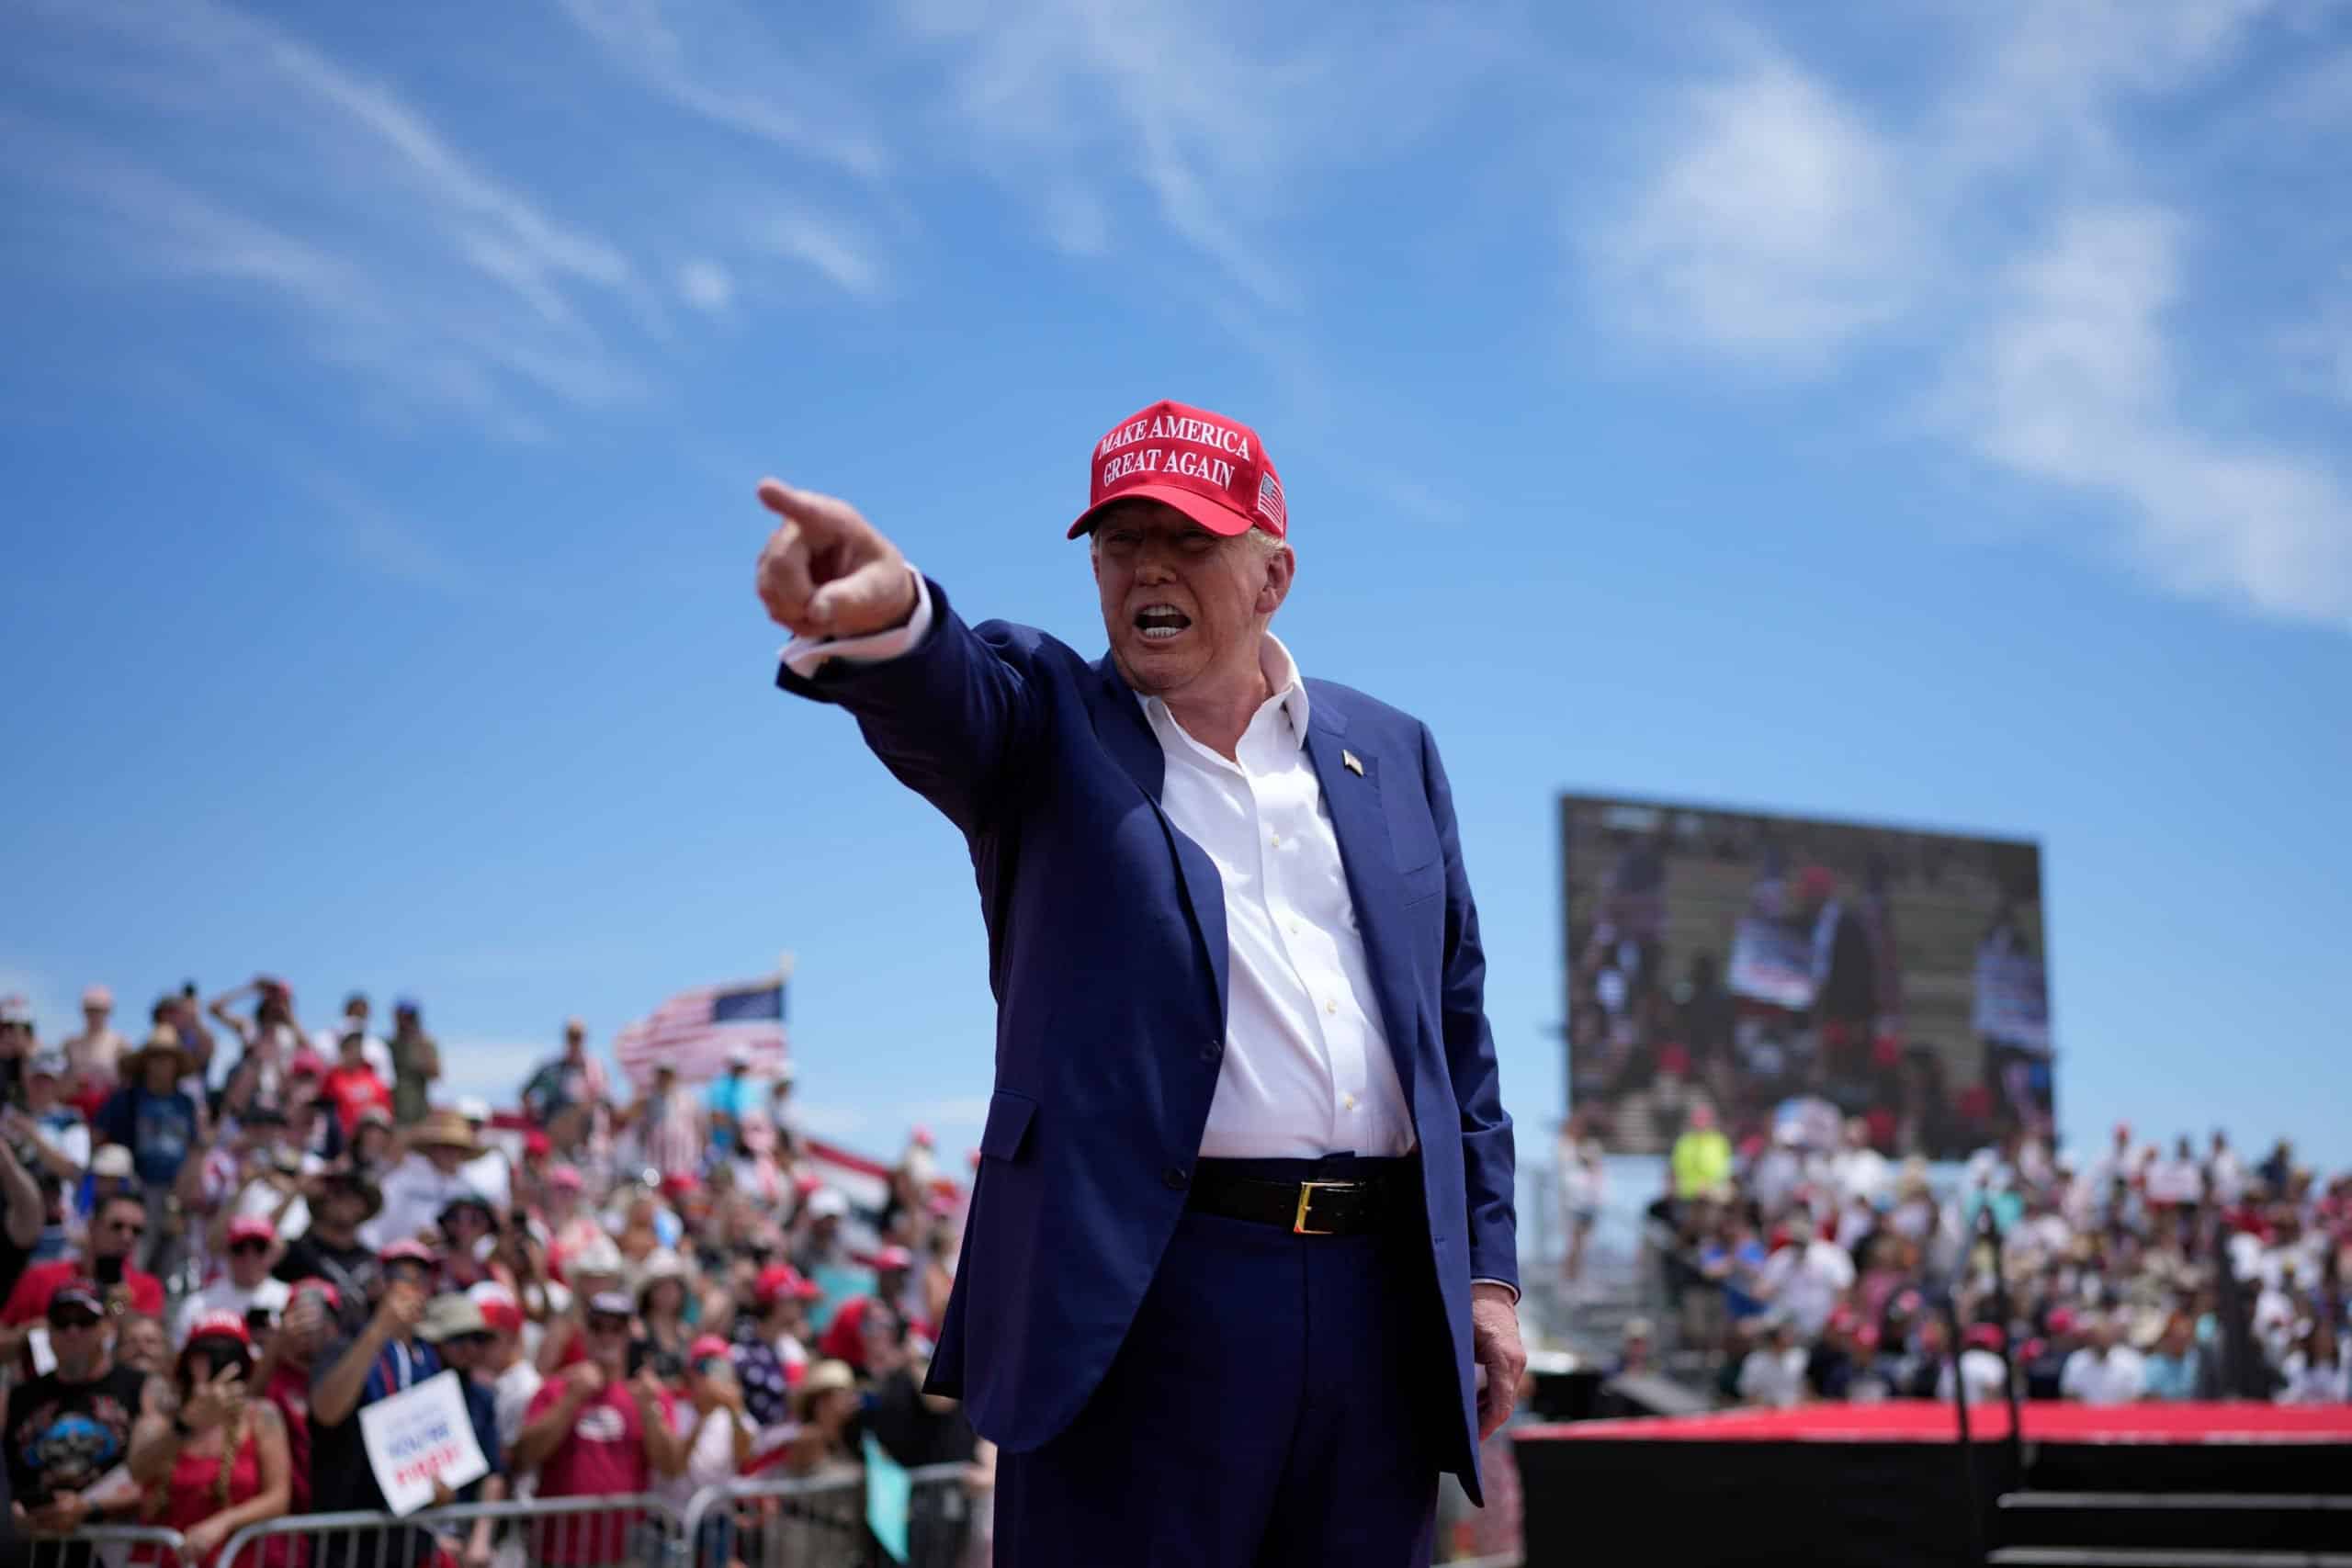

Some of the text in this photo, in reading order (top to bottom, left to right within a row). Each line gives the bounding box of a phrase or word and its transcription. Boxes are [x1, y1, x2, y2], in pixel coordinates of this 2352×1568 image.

[1098, 415, 1250, 462] MAKE AMERICA
[1103, 449, 1236, 491] GREAT AGAIN
